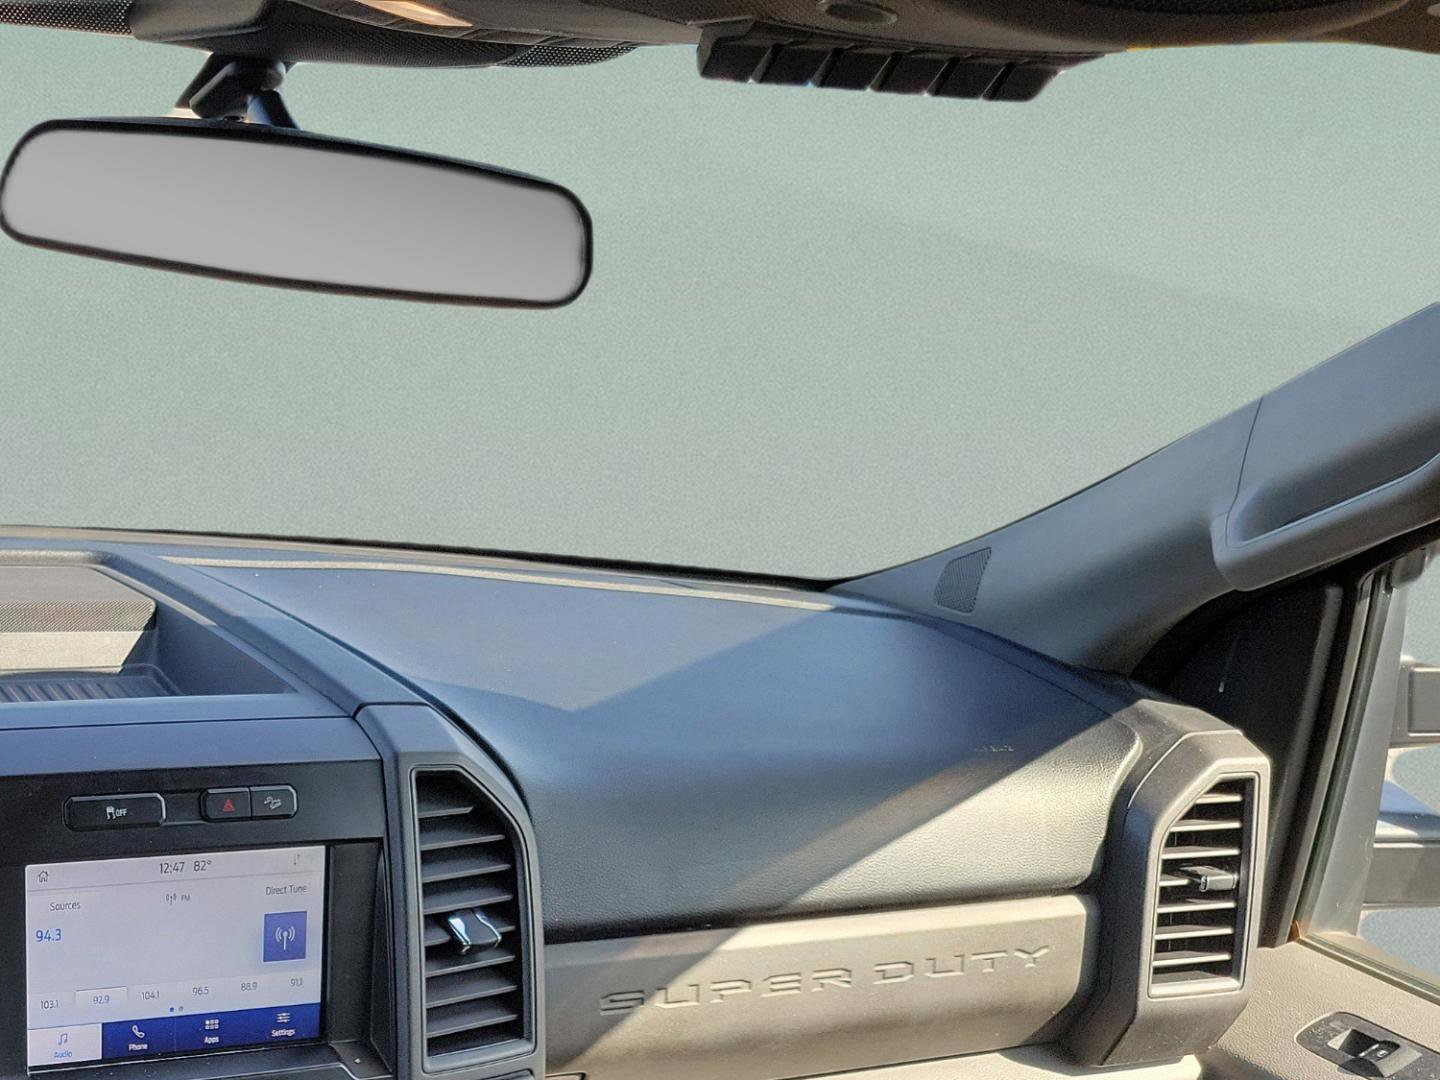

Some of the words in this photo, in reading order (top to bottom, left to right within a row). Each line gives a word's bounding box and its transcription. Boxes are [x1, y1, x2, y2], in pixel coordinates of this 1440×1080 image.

[159, 861, 185, 875] 12:47
[265, 884, 287, 896] Direct
[49, 901, 81, 912] Sources
[35, 928, 62, 942] 94.3
[599, 967, 853, 1016] SUPER
[872, 945, 1051, 985] DUTY
[192, 986, 209, 996] 96.5
[92, 994, 110, 1004] 92.9
[271, 1028, 296, 1037] Settings
[204, 1036, 220, 1045] Apps
[128, 1043, 148, 1052] Phone
[53, 1050, 73, 1058] Audio
